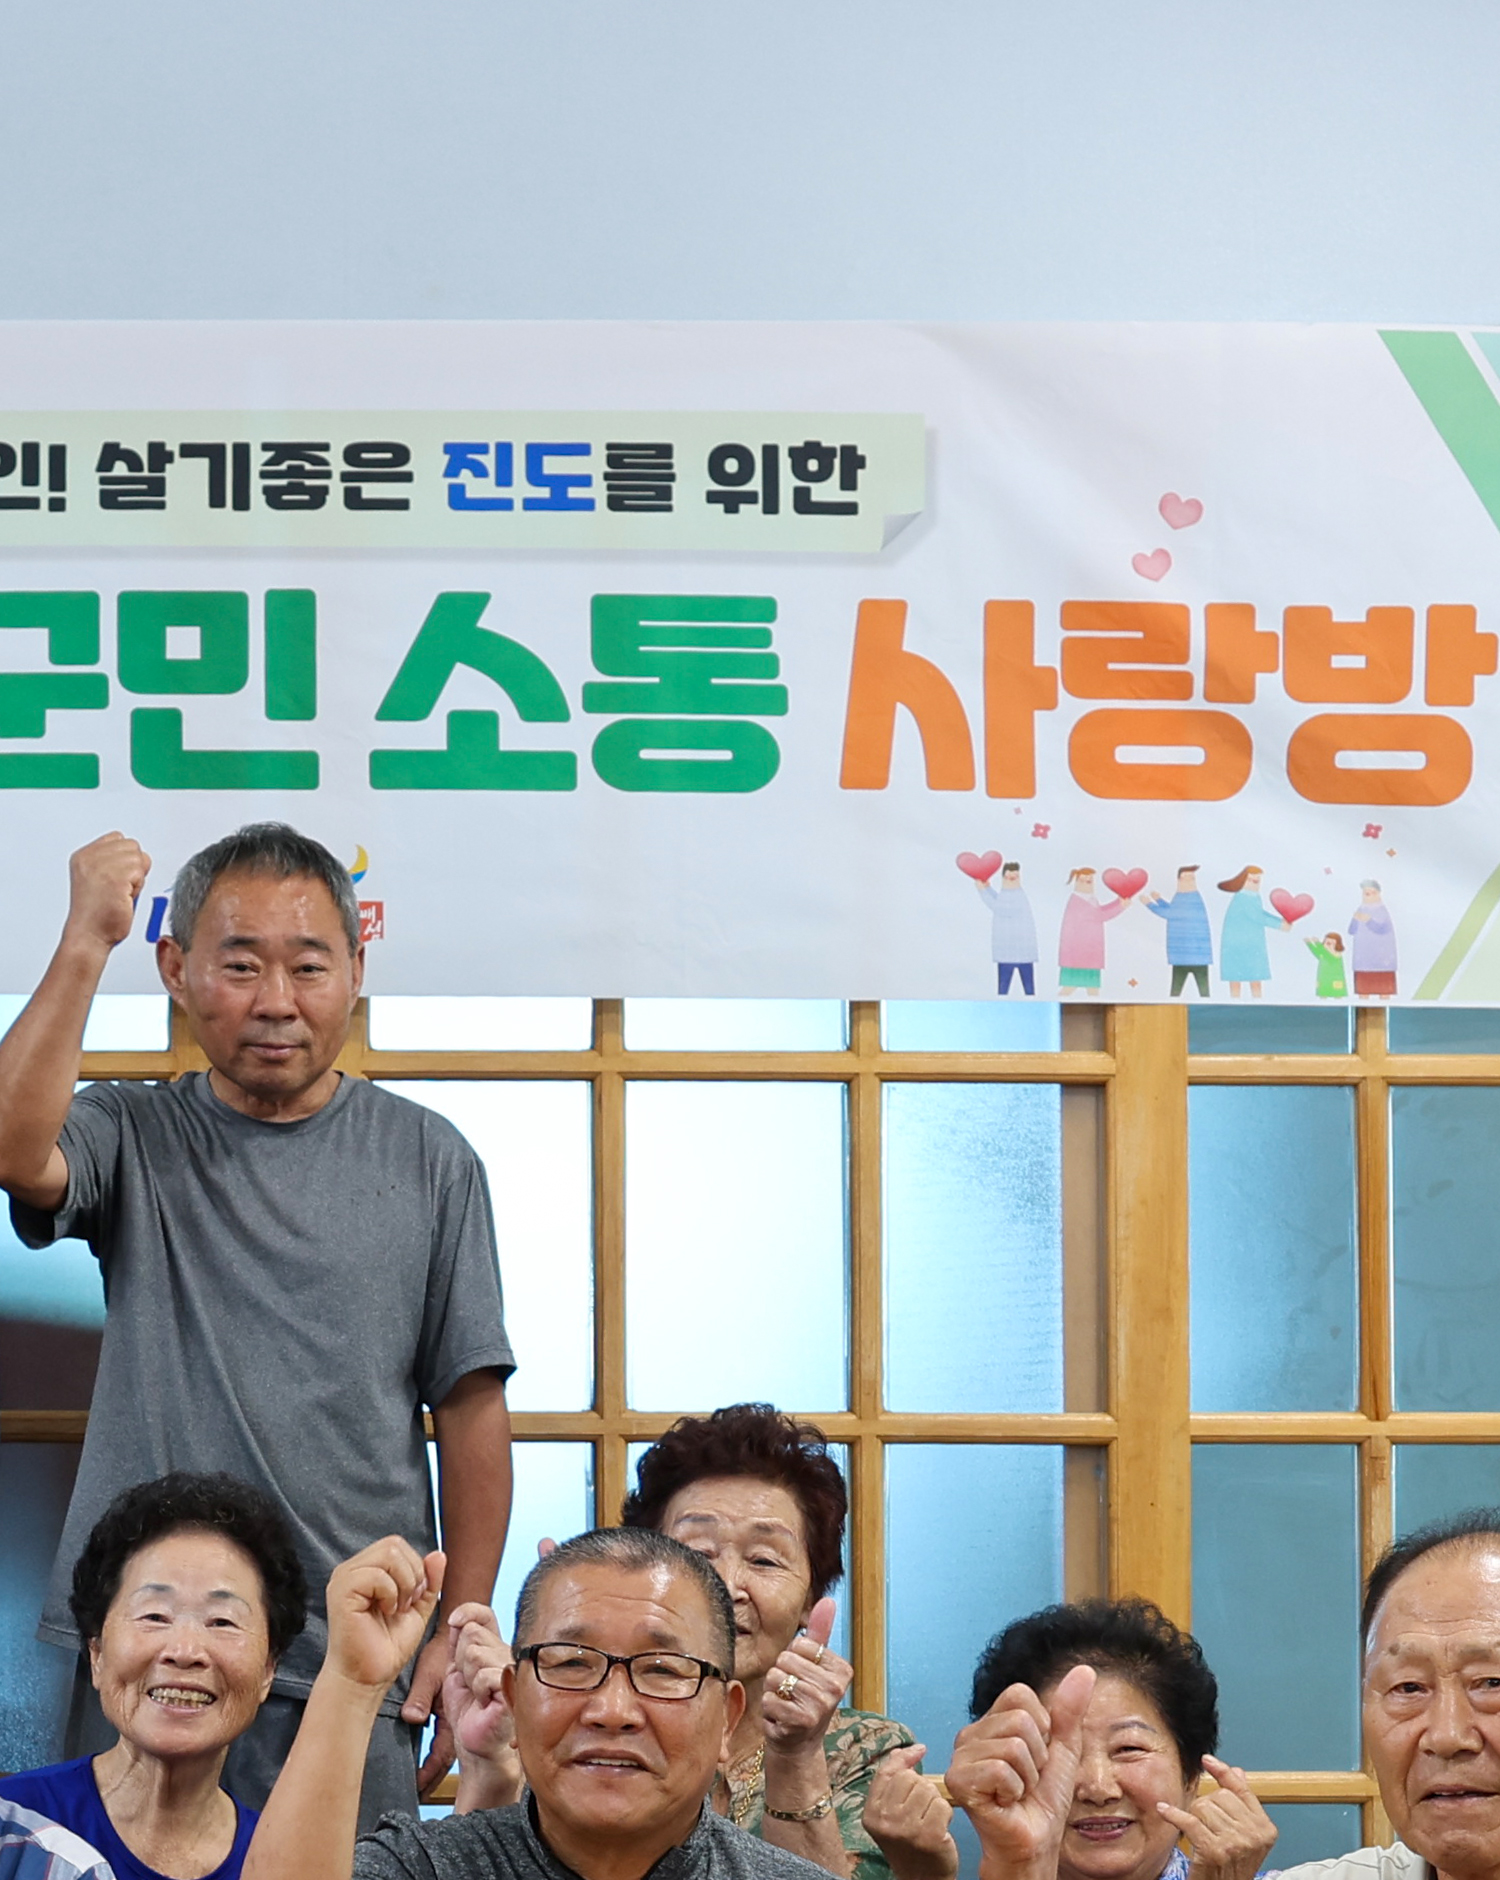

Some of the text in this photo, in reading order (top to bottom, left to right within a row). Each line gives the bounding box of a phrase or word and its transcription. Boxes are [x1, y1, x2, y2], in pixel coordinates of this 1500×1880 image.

[95, 440, 414, 512] 살기좋은
[442, 440, 676, 512] 진도를
[705, 440, 866, 515] 위한
[369, 592, 788, 792] 소통
[841, 599, 1498, 806] 사랑방
